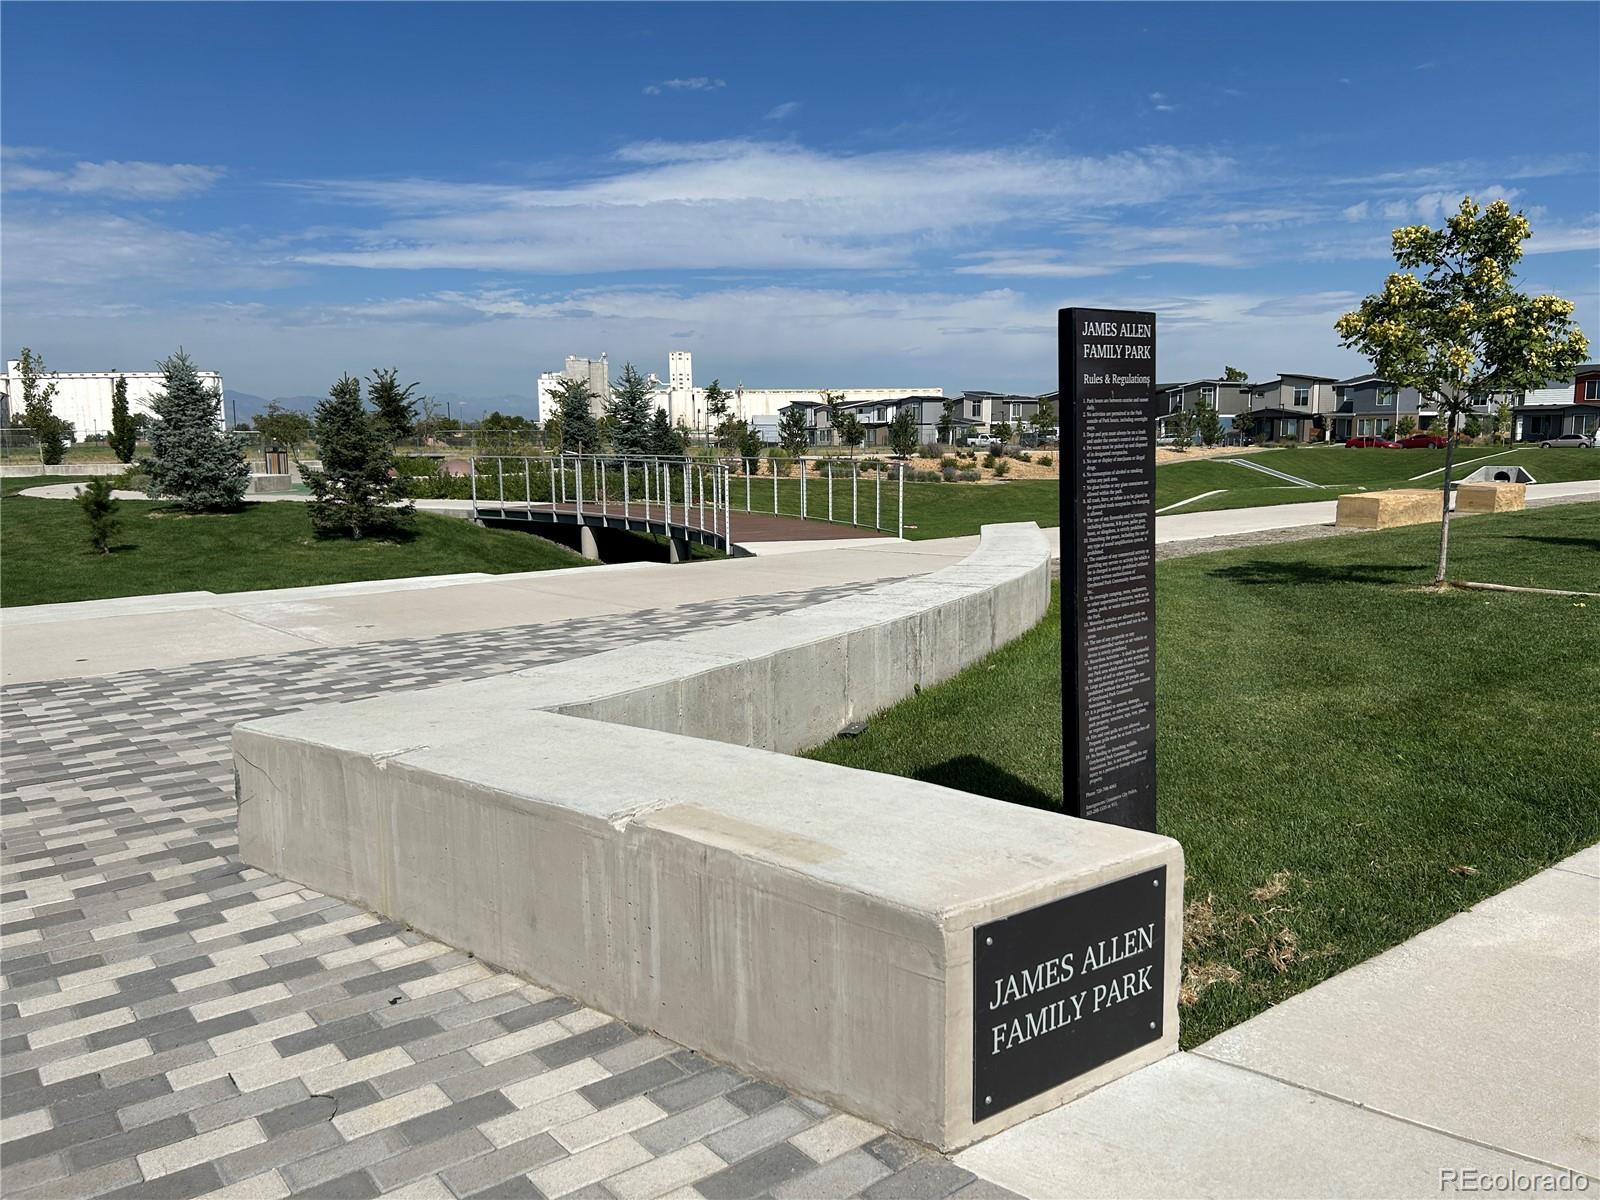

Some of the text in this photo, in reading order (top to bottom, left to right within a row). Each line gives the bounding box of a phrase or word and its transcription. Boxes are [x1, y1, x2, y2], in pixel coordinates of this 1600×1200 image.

[1082, 322, 1151, 338] JAMES ALLEN
[1083, 344, 1151, 359] FAMILY PARK
[1083, 374, 1150, 386] Rules & Regulations
[989, 923, 1155, 1011] JAMES ALLEN
[991, 965, 1153, 1055] FAMILY PARK
